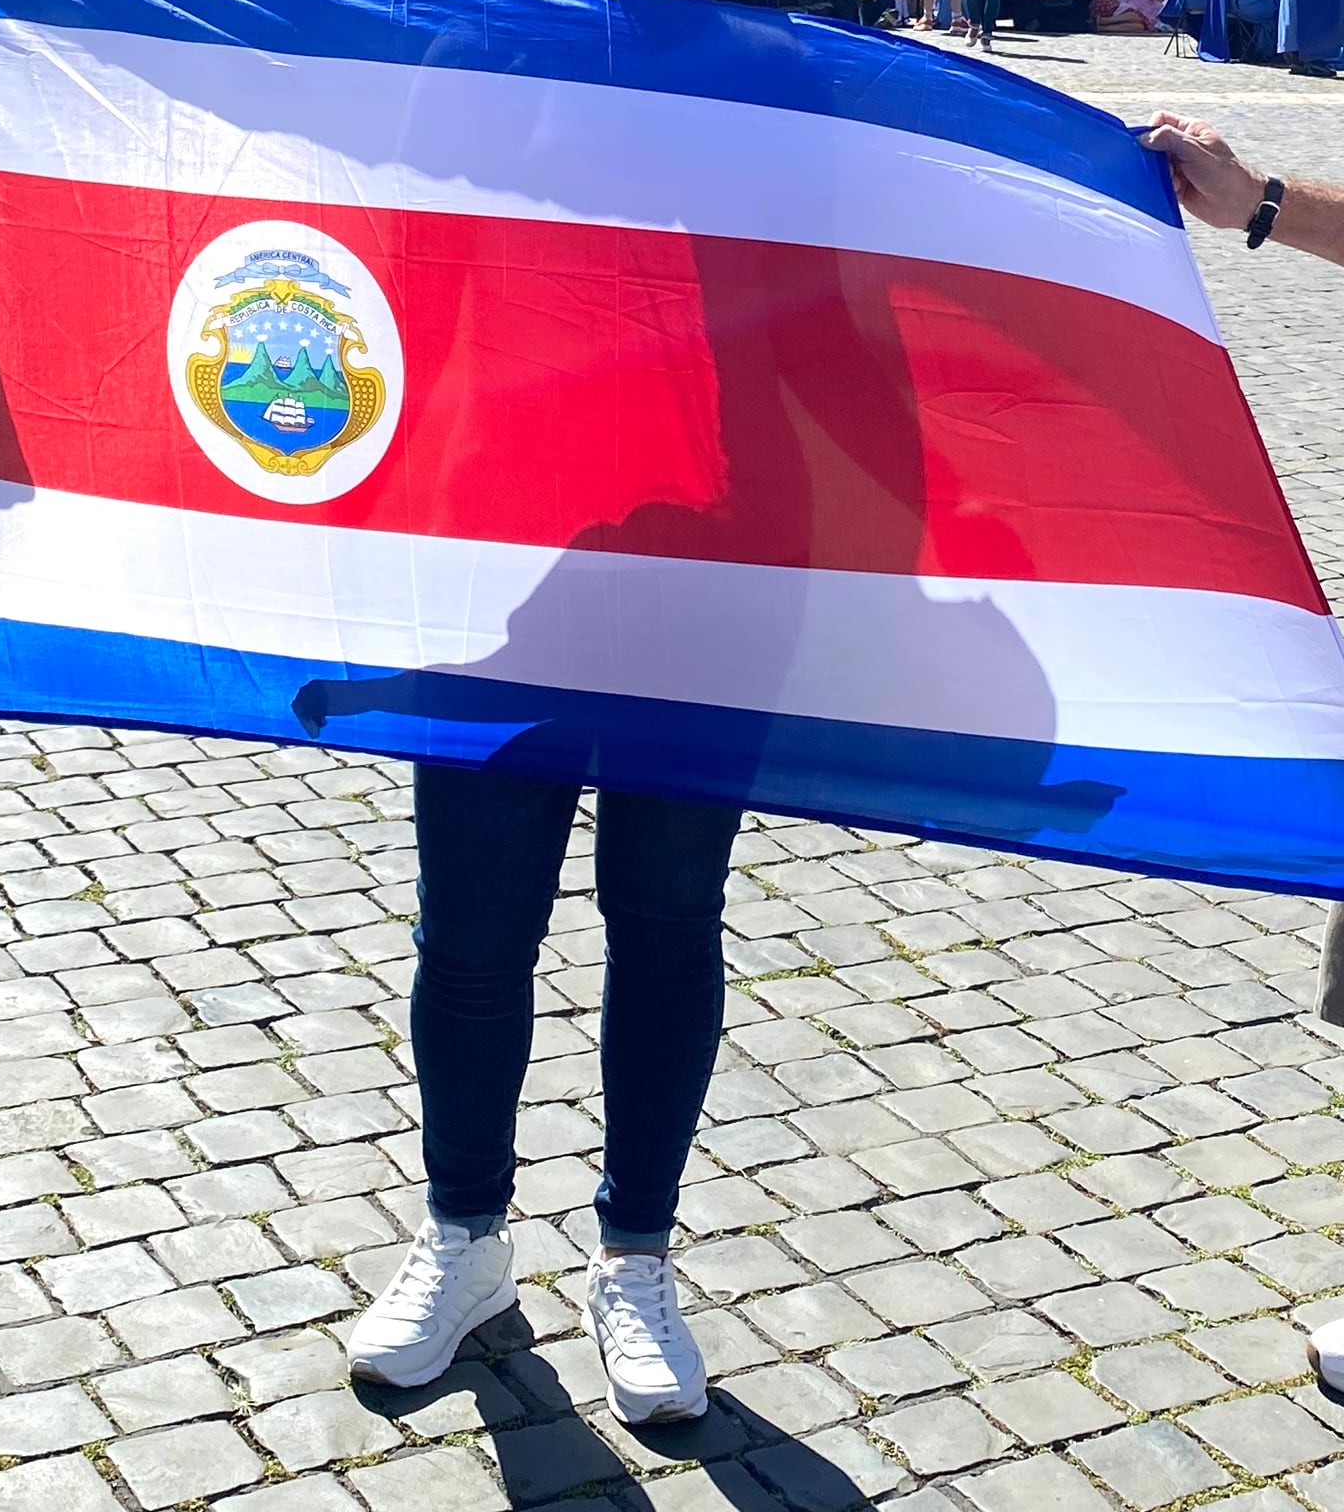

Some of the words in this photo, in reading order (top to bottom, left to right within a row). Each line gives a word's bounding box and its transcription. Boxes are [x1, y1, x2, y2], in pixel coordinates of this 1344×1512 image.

[276, 305, 288, 314] DE
[291, 302, 319, 321] COSTA
[319, 318, 337, 334] RICA
